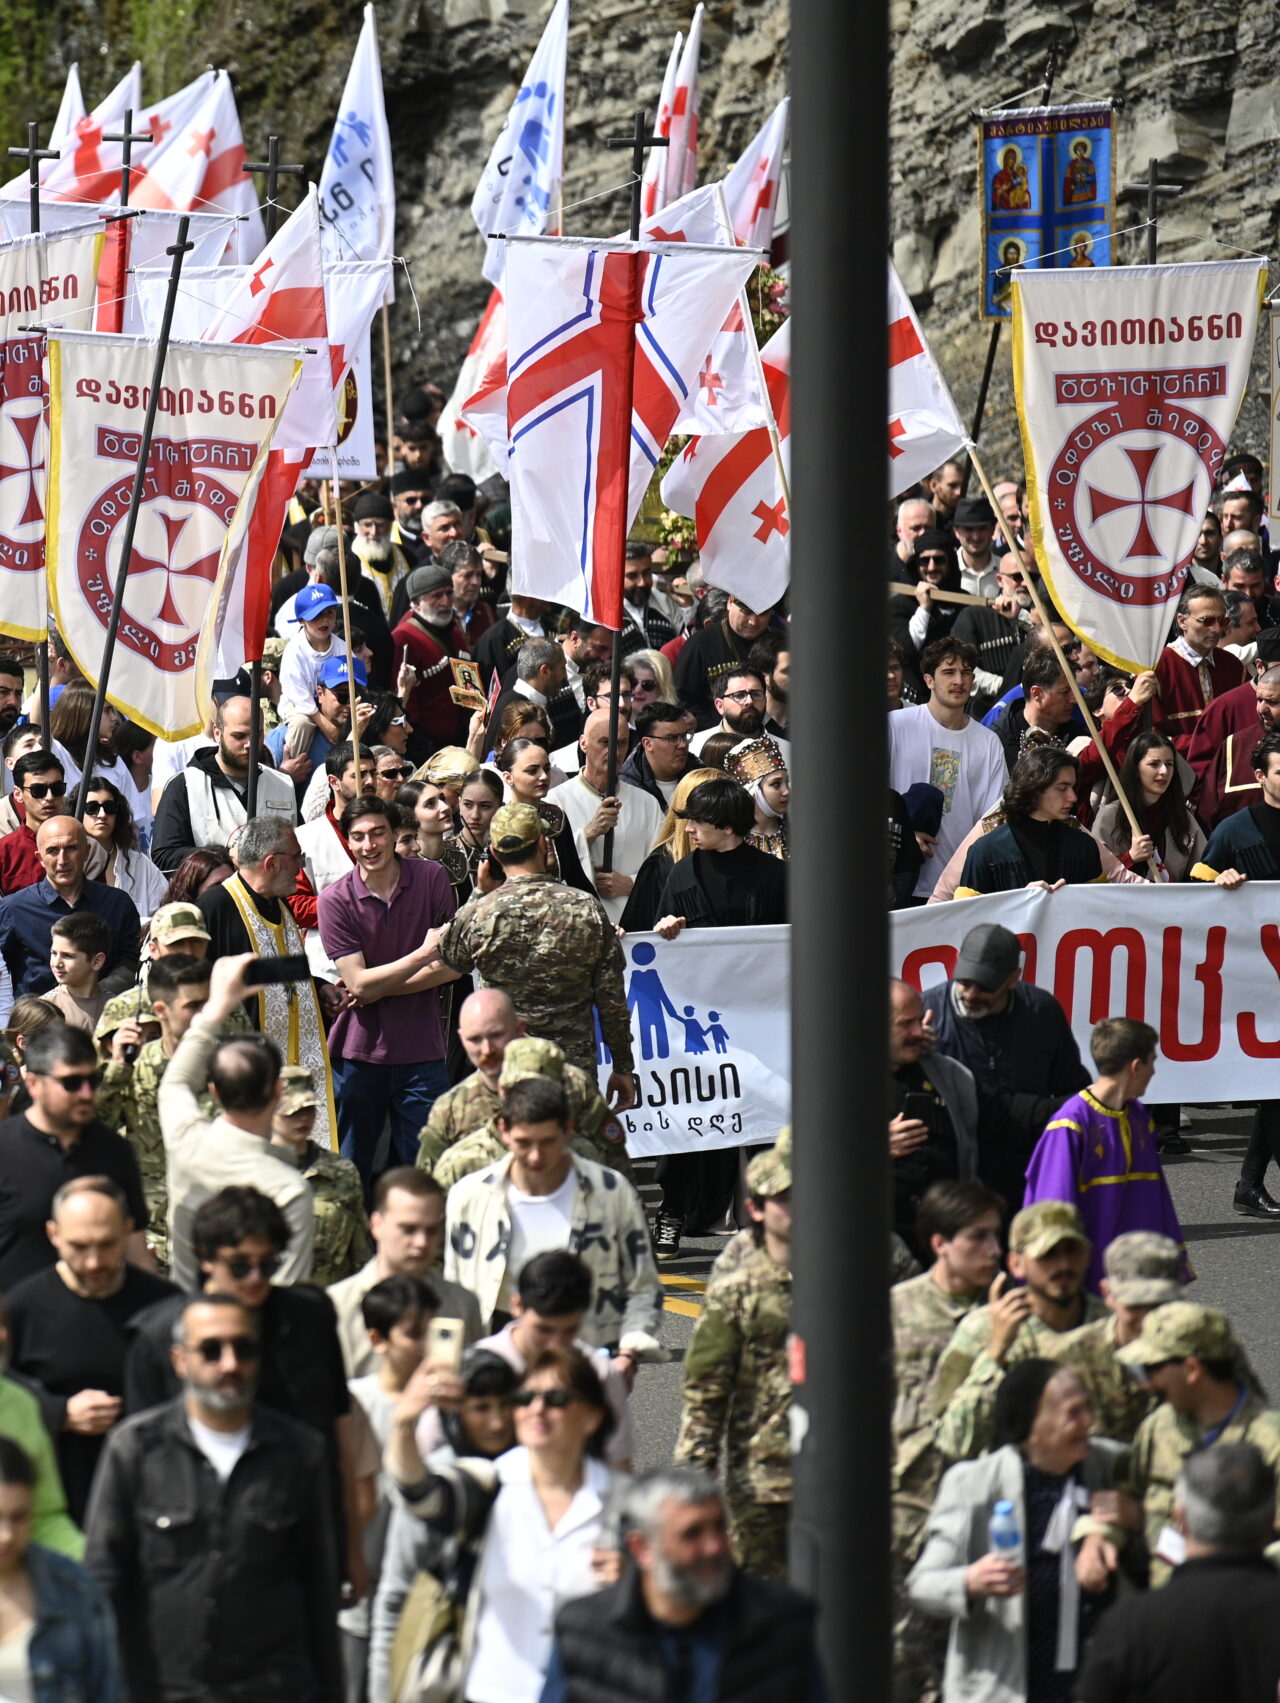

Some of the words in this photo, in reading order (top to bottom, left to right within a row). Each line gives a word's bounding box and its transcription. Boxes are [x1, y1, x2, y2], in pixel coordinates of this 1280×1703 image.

[1034, 312, 1243, 348] დავითიანნი
[1057, 523, 1135, 599] უფალი
[86, 573, 159, 659] უფლი
[625, 1110, 670, 1134] ხის
[687, 1112, 743, 1137] დღე
